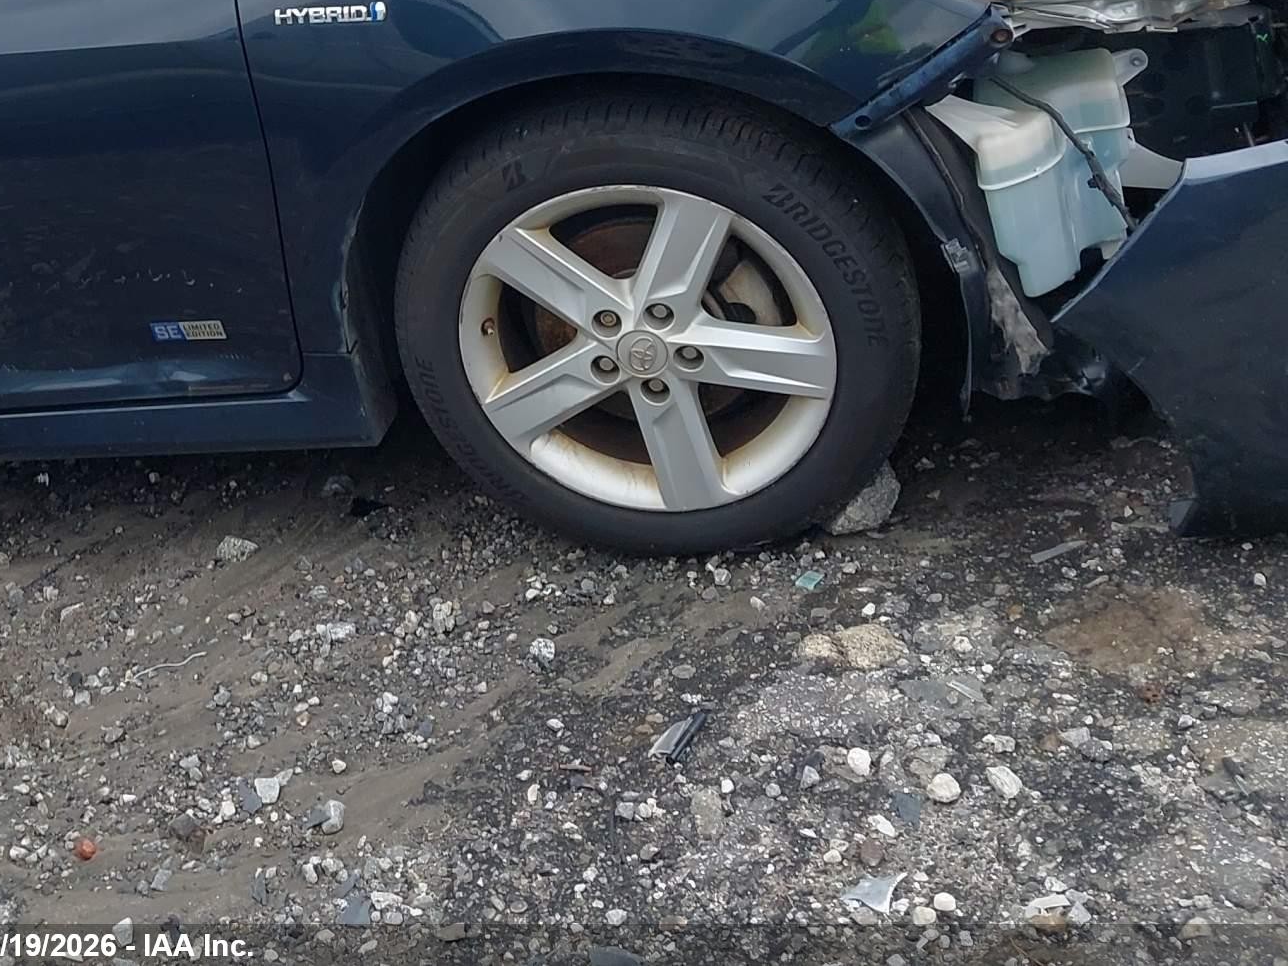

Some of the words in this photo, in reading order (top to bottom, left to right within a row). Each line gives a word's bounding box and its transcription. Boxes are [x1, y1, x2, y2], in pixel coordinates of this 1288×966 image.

[274, 5, 368, 26] HYBRID
[761, 182, 889, 347] BRIDGESTONE
[154, 325, 182, 339] SE
[182, 322, 220, 331] LIMITED
